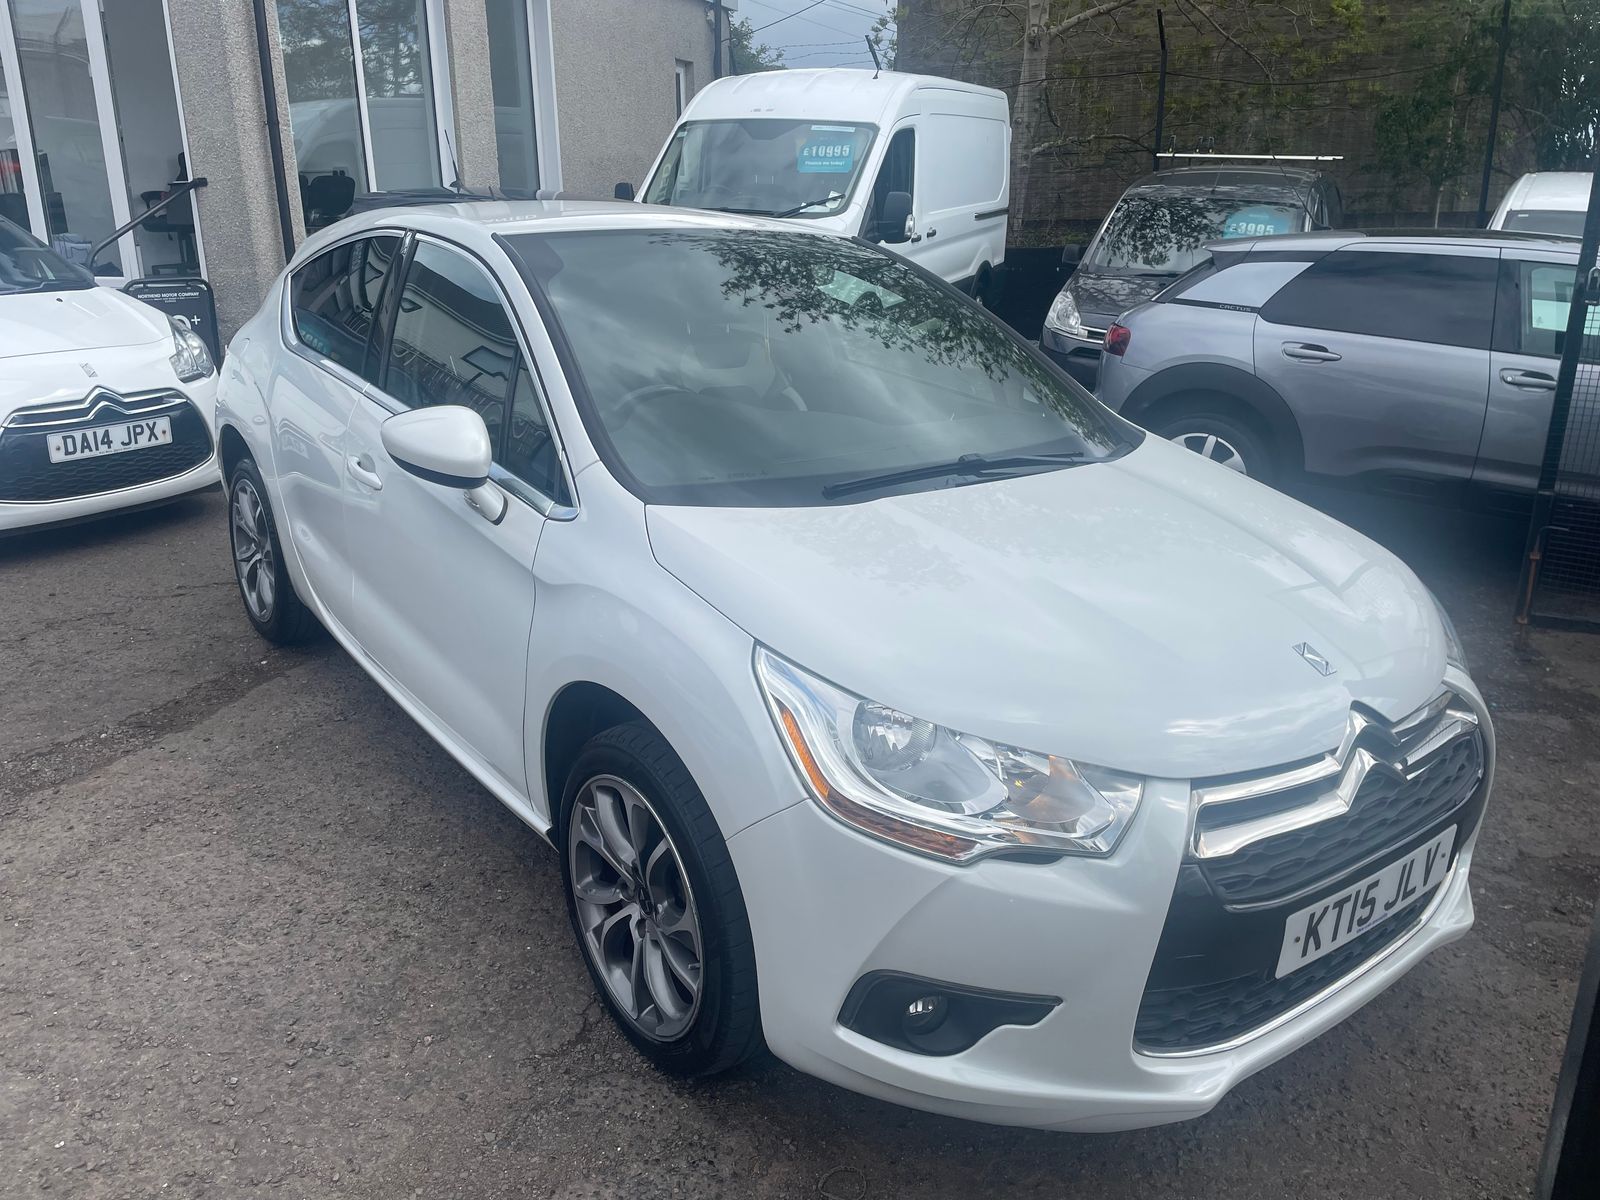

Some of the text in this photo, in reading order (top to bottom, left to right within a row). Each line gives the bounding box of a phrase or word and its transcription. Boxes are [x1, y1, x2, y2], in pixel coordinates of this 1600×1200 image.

[803, 145, 850, 157] £10995
[1229, 222, 1275, 236] £3995
[1219, 304, 1252, 312] CACTUS
[62, 421, 159, 456] DA14 JPX
[1301, 841, 1442, 958] KT15 JLV
